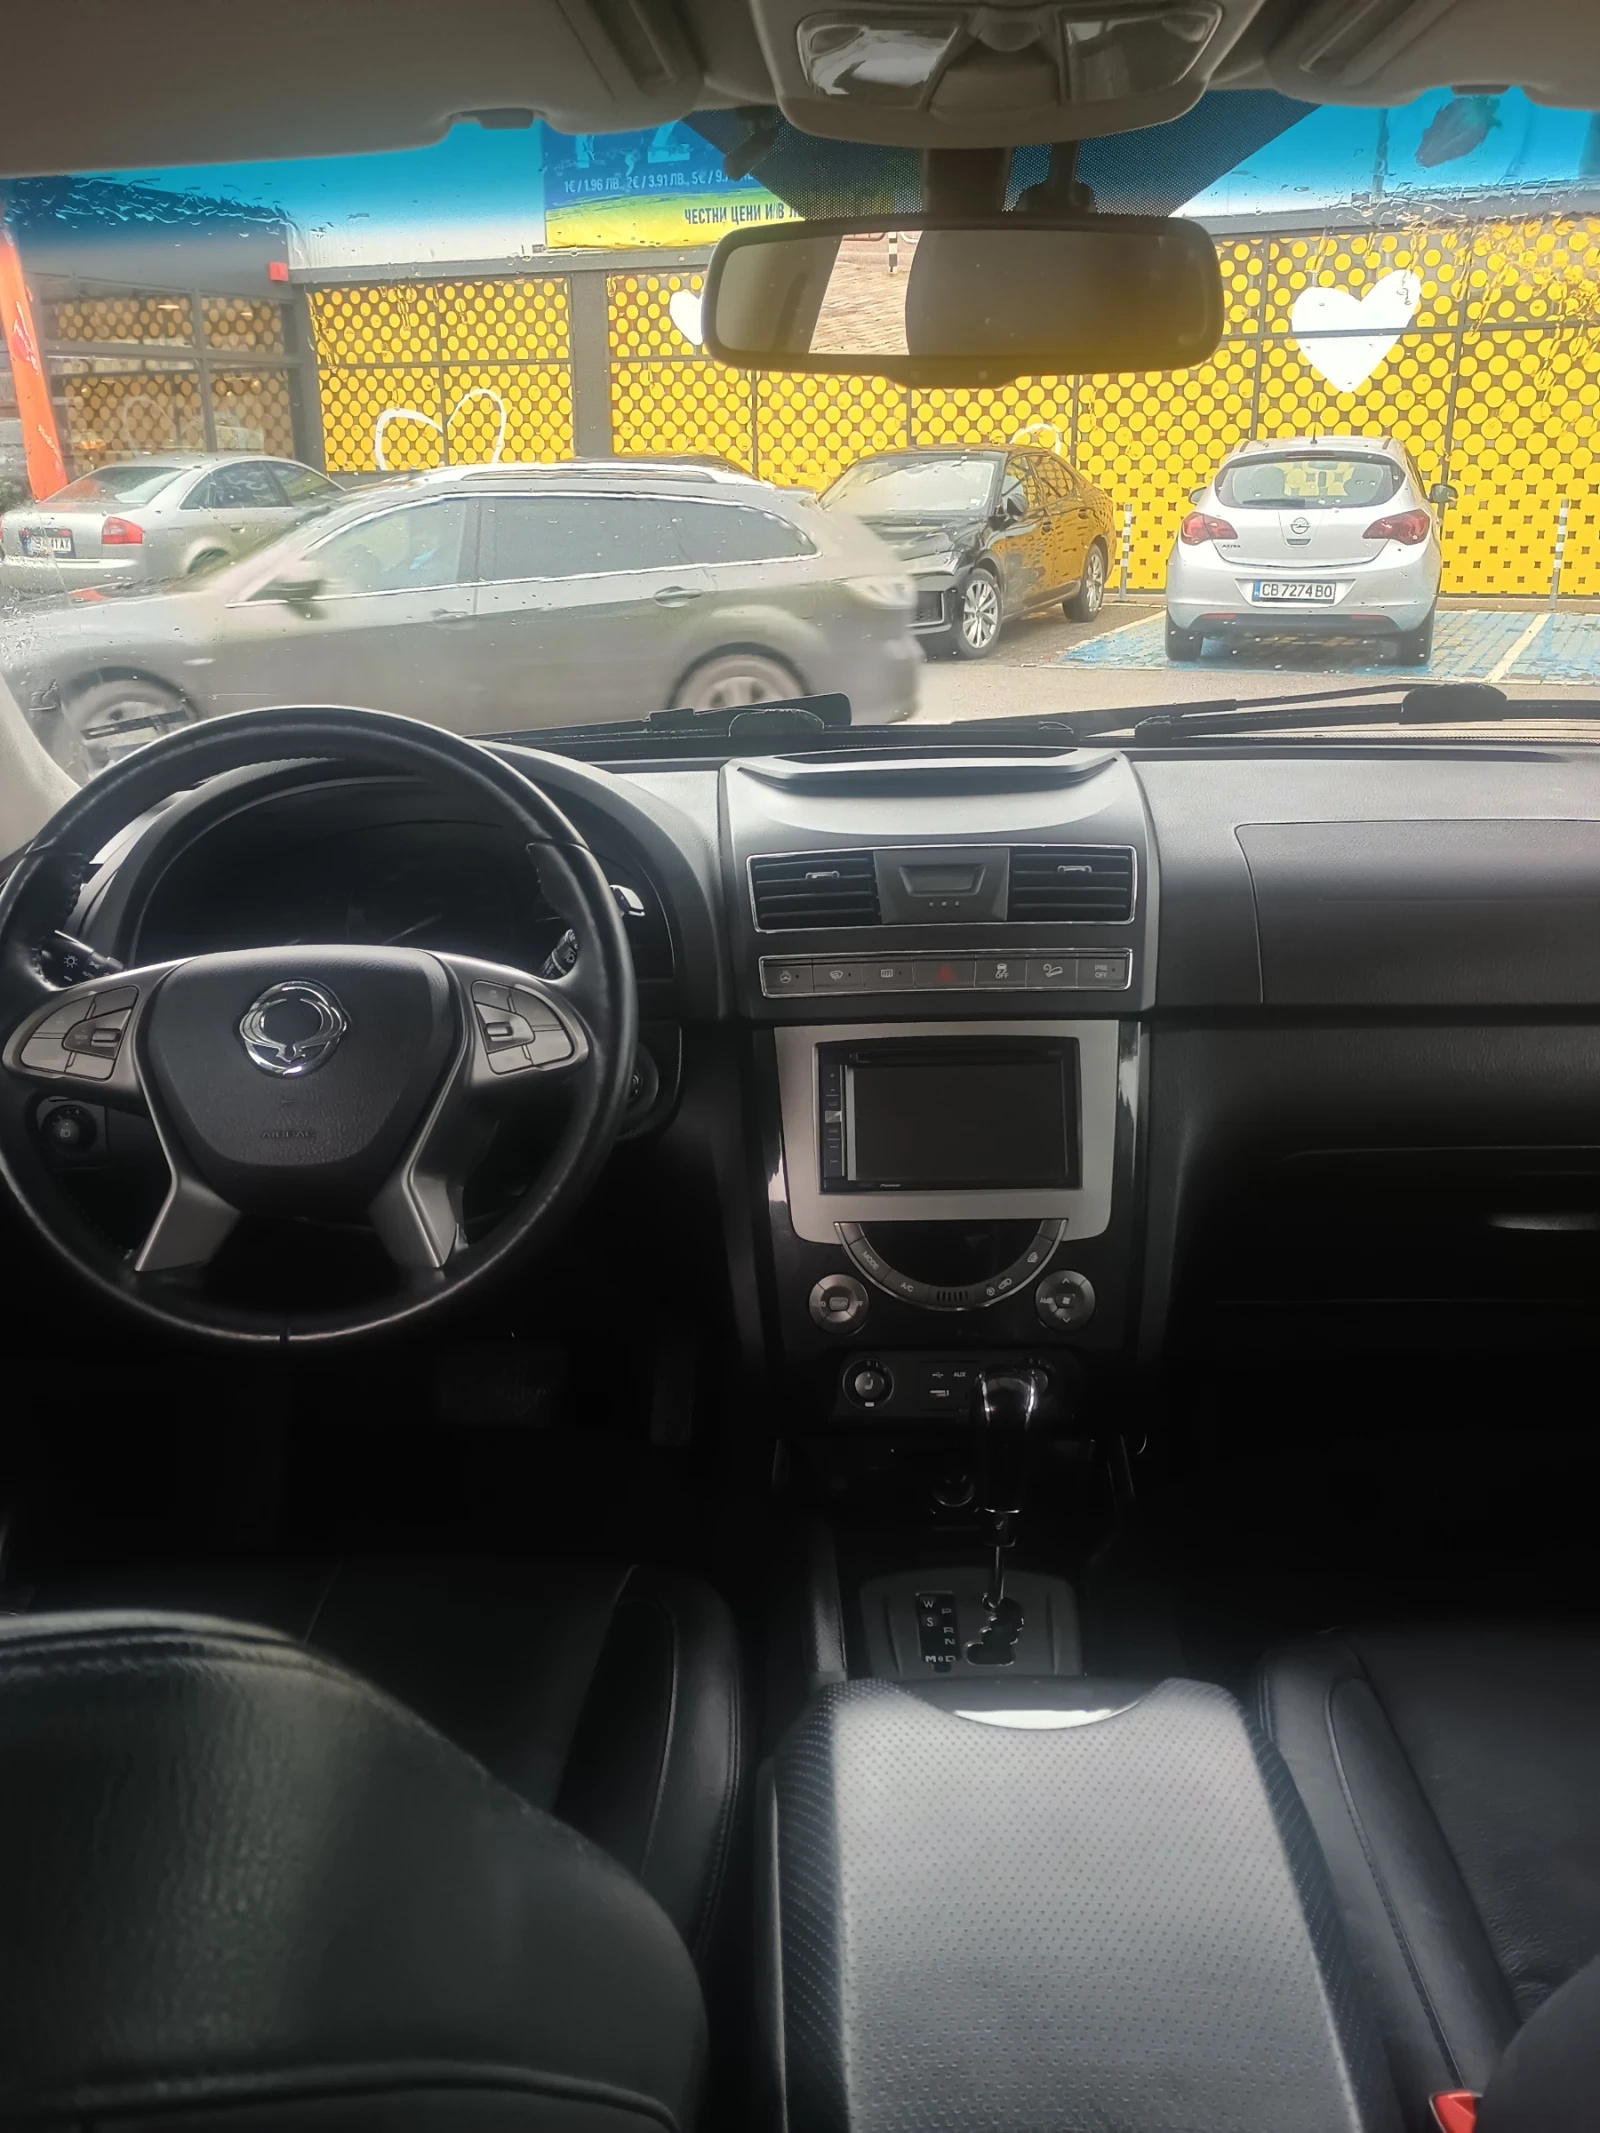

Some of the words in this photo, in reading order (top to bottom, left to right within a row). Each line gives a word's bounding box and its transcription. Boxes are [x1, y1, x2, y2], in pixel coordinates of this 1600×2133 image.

[583, 179, 603, 191] 1.96
[648, 174, 668, 187] 3.91
[684, 206, 728, 225] ЧЕСТНИ
[731, 204, 761, 225] ЦЕНИ
[1281, 583, 1313, 597] 7274
[953, 1370, 966, 1378] AUX
[926, 1616, 934, 1627] S
